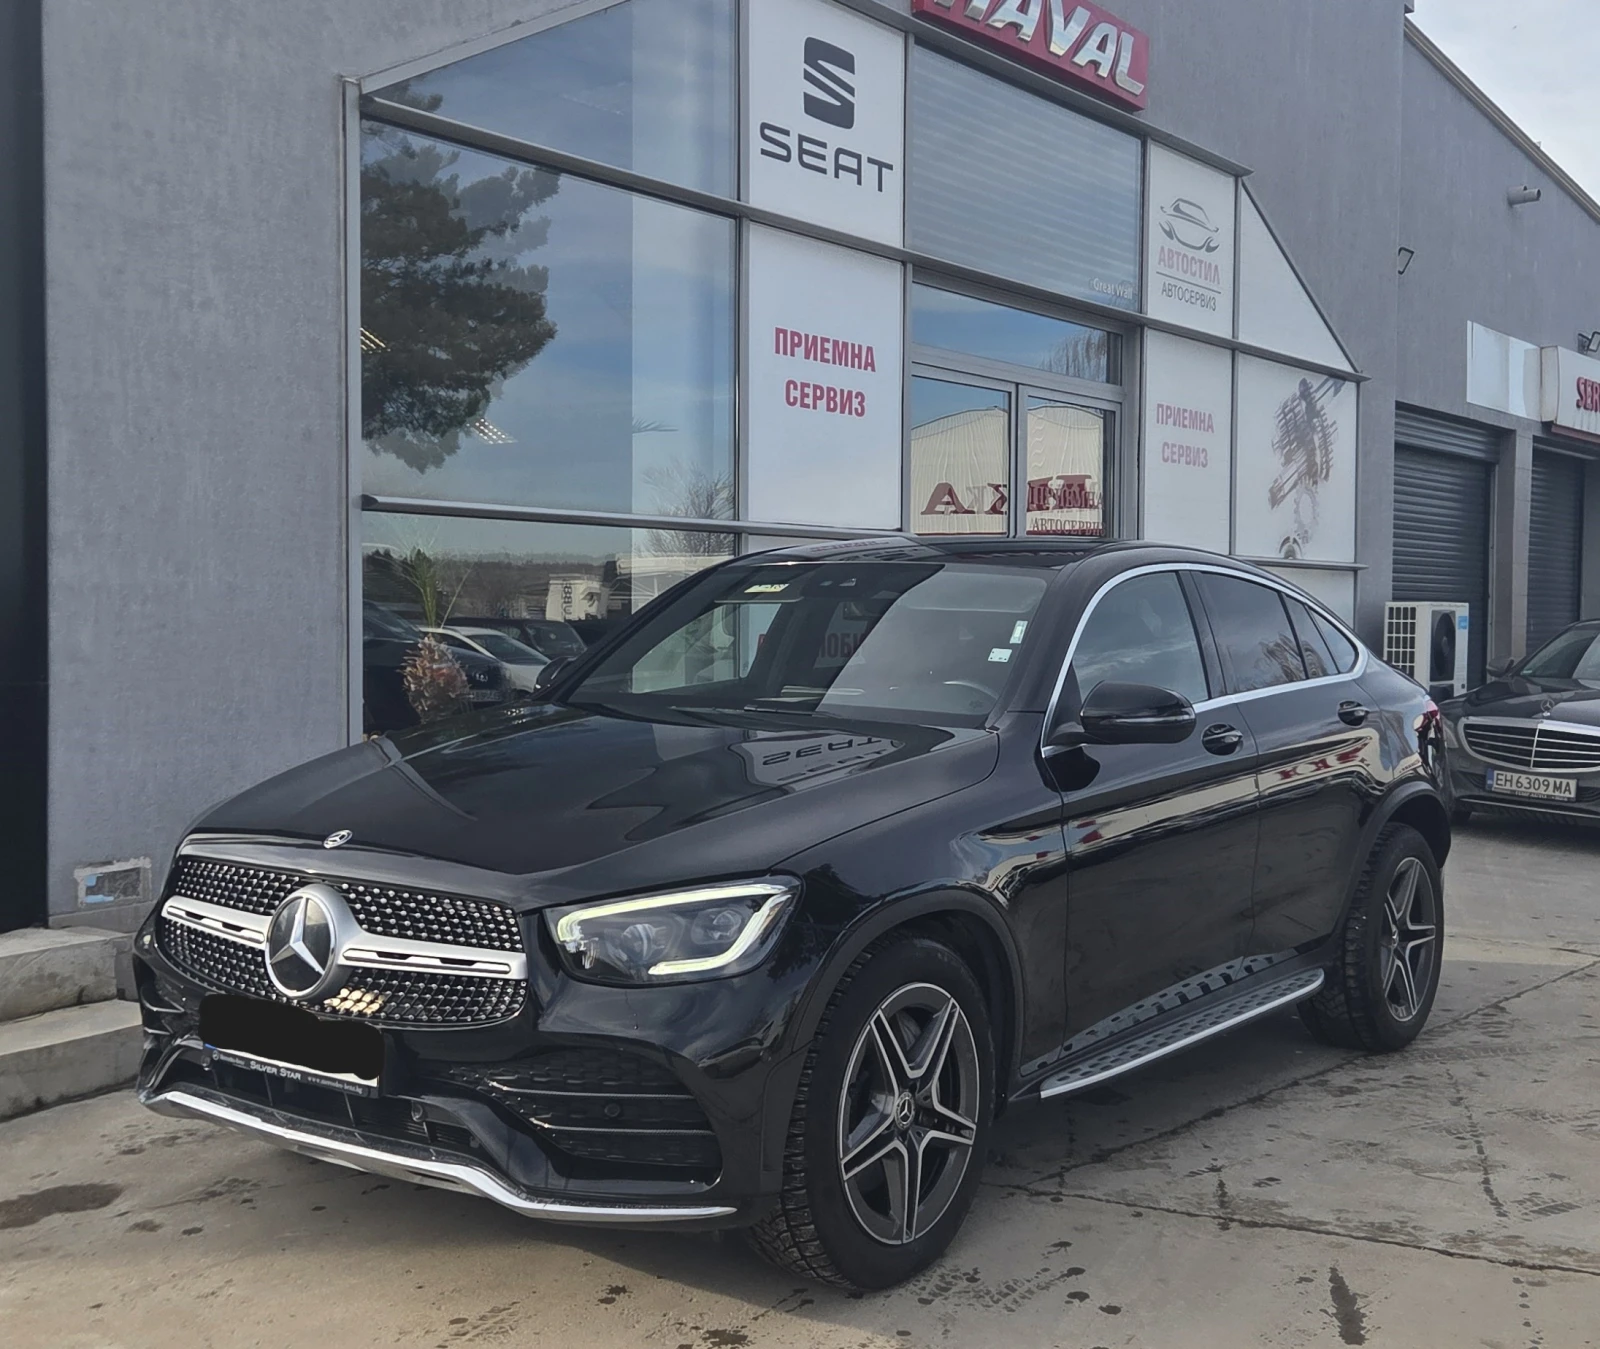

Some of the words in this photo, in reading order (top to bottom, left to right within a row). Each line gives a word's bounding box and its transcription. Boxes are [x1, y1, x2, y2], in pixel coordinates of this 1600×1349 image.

[934, 0, 1145, 96] AVAL
[759, 121, 894, 193] SEAT
[1157, 245, 1221, 285] АВТОСТИЛ
[1161, 281, 1217, 312] АВТОСЕРВИЗ
[775, 326, 876, 373] ПРИЕМНА
[785, 379, 866, 418] СЕРВИЗ
[1156, 402, 1215, 434] ПРИЕМНА
[1161, 441, 1209, 469] СЕРВИЗ
[1515, 775, 1550, 793] 6309
